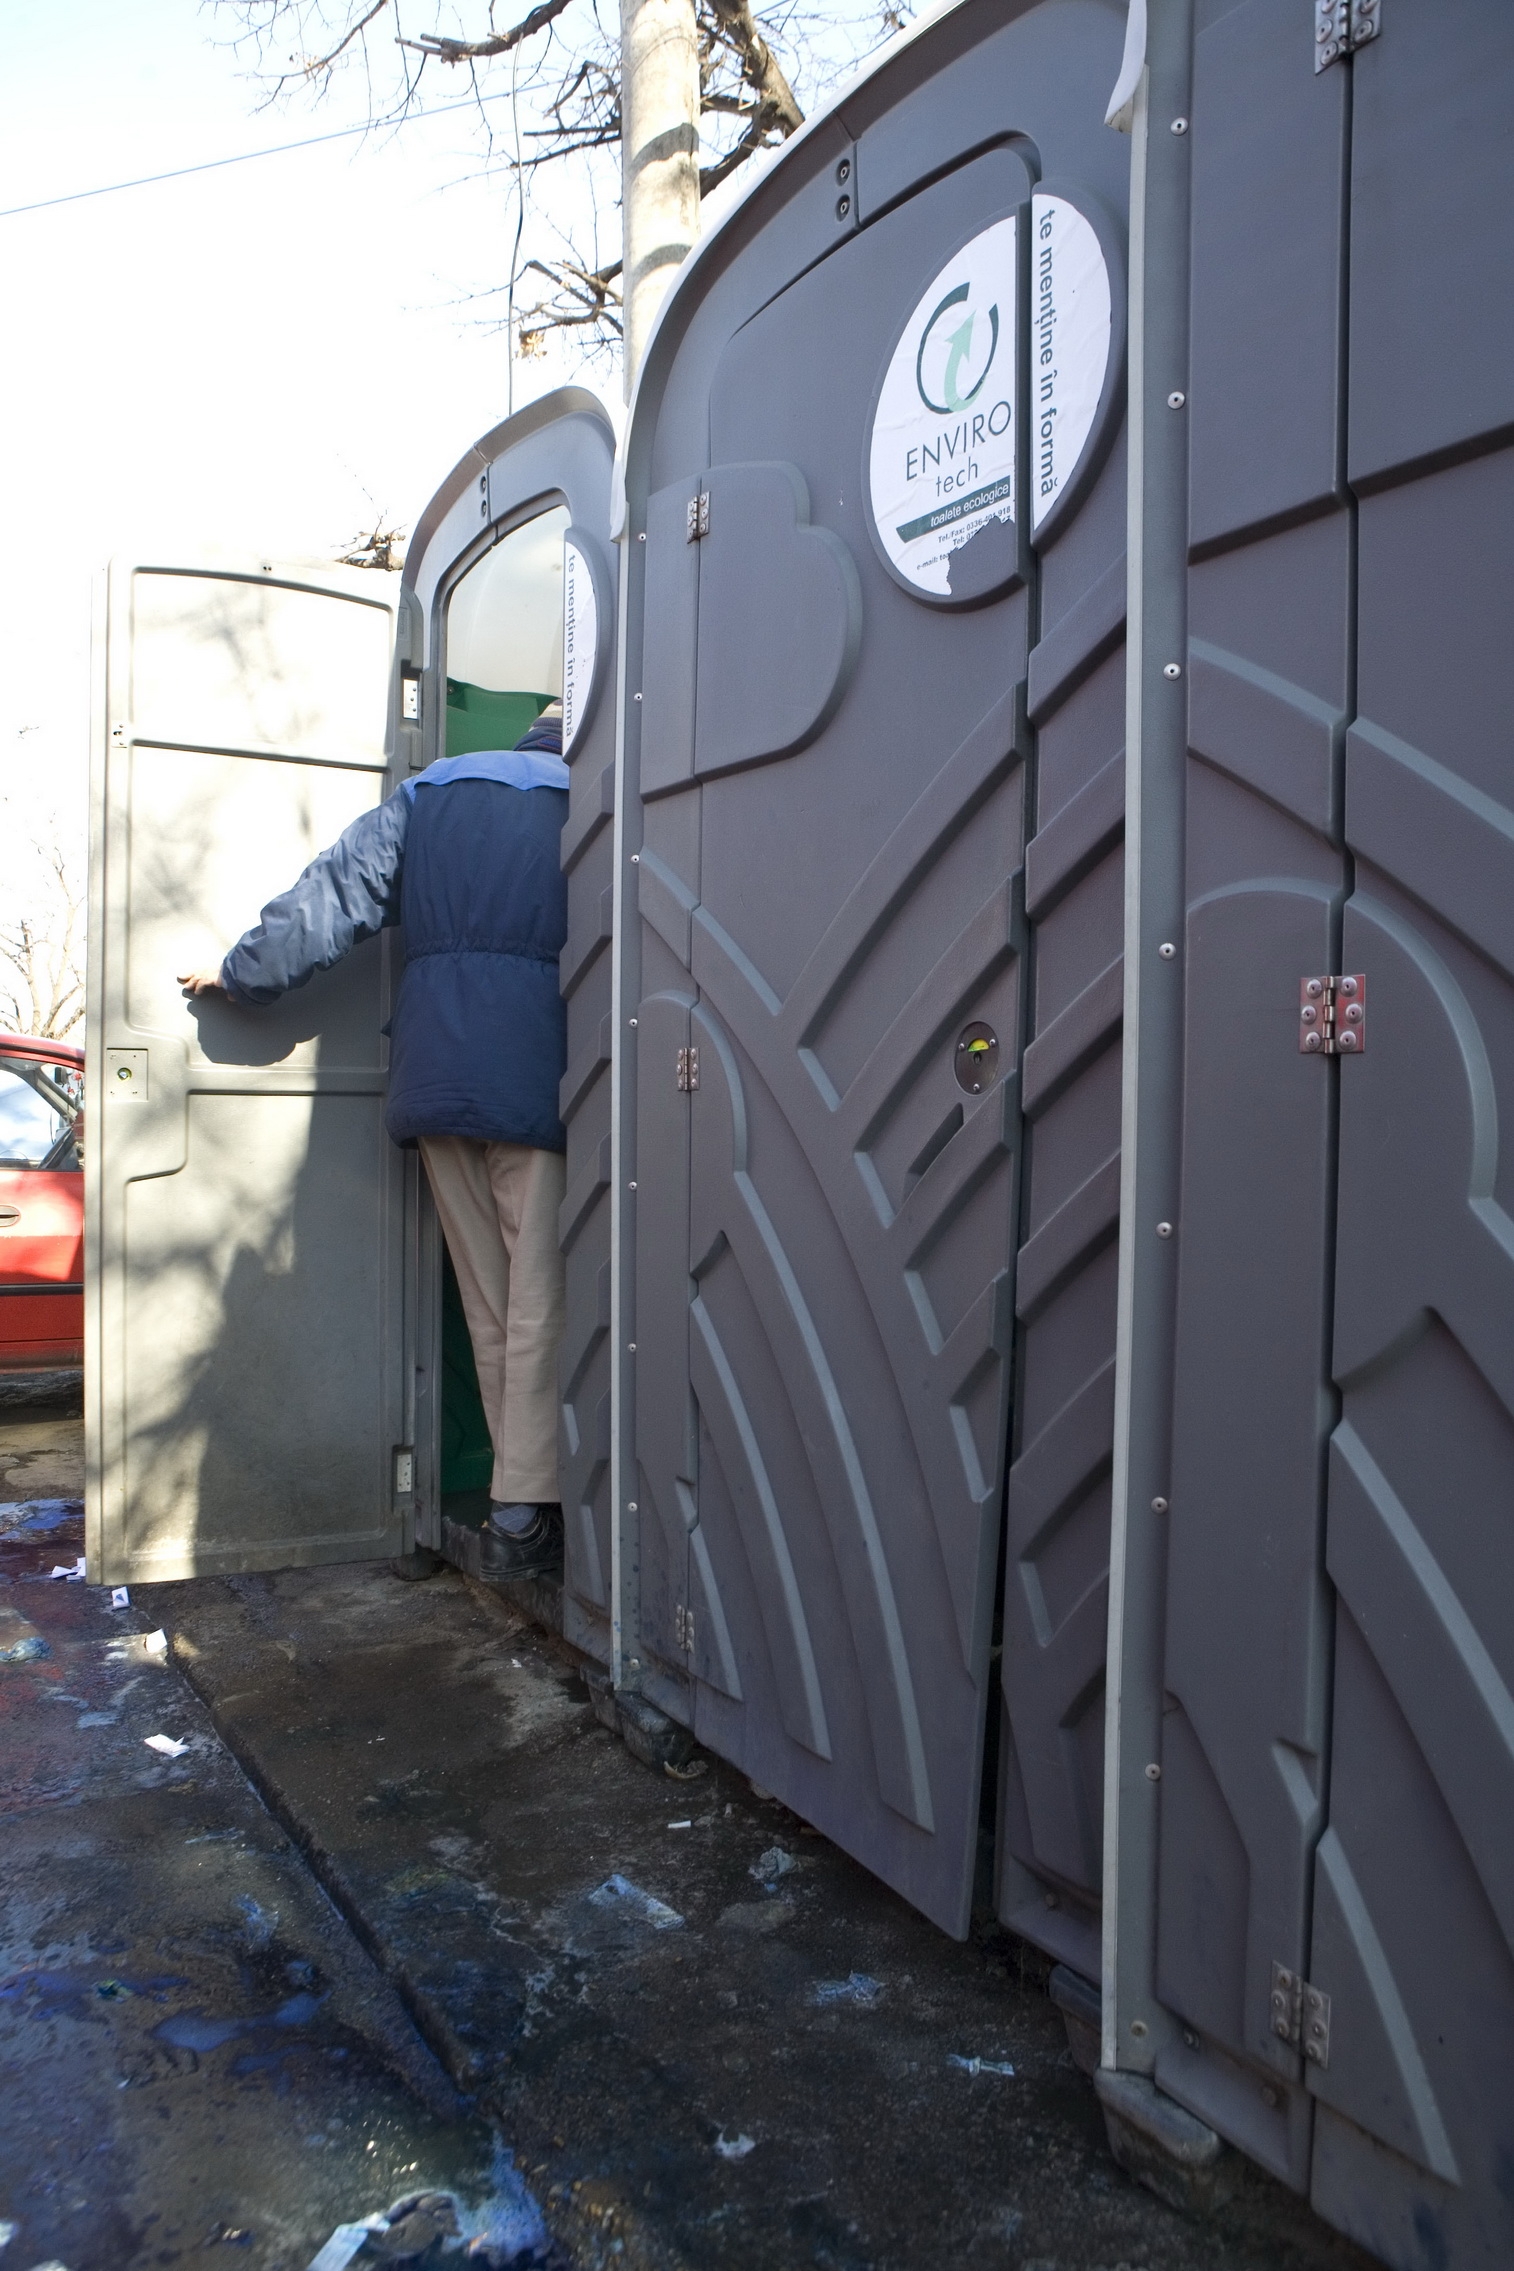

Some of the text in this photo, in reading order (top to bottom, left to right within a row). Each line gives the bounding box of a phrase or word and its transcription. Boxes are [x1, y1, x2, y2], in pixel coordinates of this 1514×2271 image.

[1039, 208, 1056, 241] te
[1040, 369, 1058, 402] în
[906, 400, 1012, 482] ENVIRO
[1040, 407, 1058, 497] formă
[935, 456, 979, 498] tech
[930, 483, 1009, 528] toalete ecologice
[568, 554, 576, 573] te
